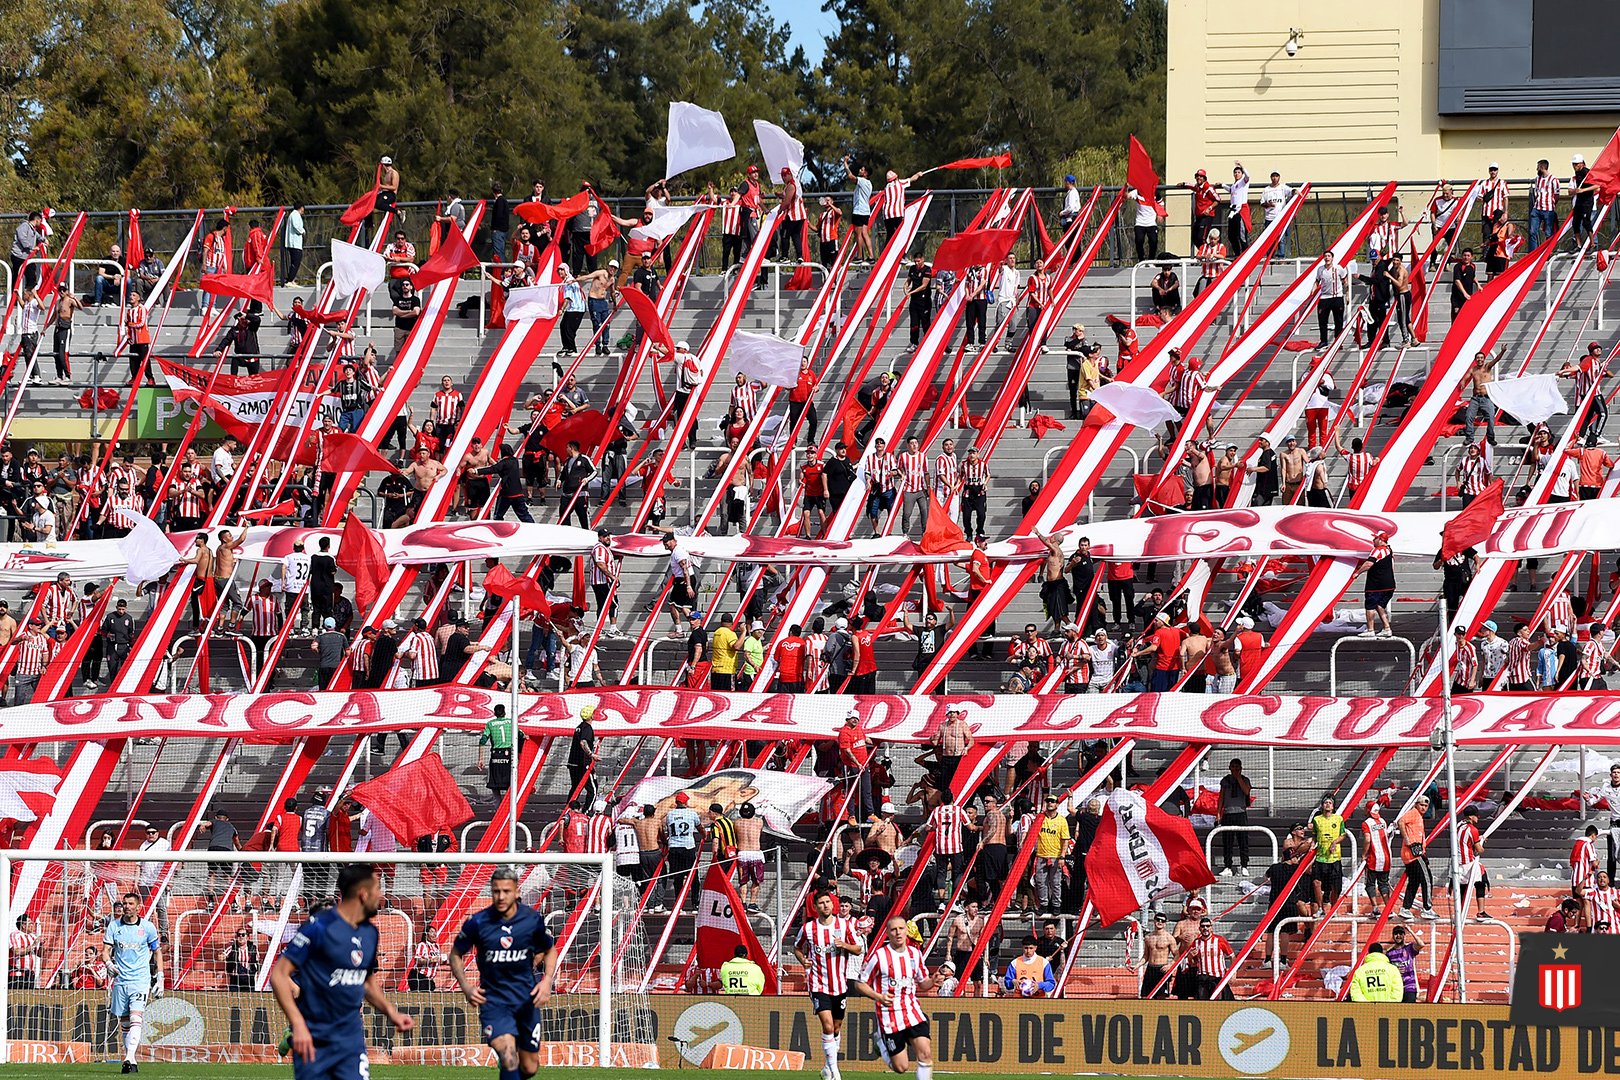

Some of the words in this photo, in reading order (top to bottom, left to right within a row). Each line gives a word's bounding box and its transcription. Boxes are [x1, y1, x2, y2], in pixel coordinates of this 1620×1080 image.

[295, 562, 309, 581] 32
[46, 692, 384, 730] UNICA
[424, 688, 797, 725] BANDA
[832, 695, 994, 736] DE
[1014, 692, 1158, 730] LA
[1201, 695, 1620, 740] CIUDAD
[499, 725, 506, 742] 1
[305, 820, 317, 837] 5
[670, 822, 690, 837] 12
[941, 821, 952, 838] 7
[729, 978, 748, 988] RL
[1366, 976, 1386, 988] RL
[136, 993, 147, 1002] 21
[531, 1023, 541, 1041] 4
[769, 1011, 812, 1060] LA
[830, 1011, 1003, 1062] IBTAD
[1018, 1013, 1065, 1063] DE
[1081, 1014, 1201, 1066] VOLAR
[1317, 1016, 1361, 1068] LA
[1378, 1018, 1561, 1072] LIBERTAD
[545, 1044, 633, 1067] LIBA
[725, 1046, 791, 1070] LIBRA
